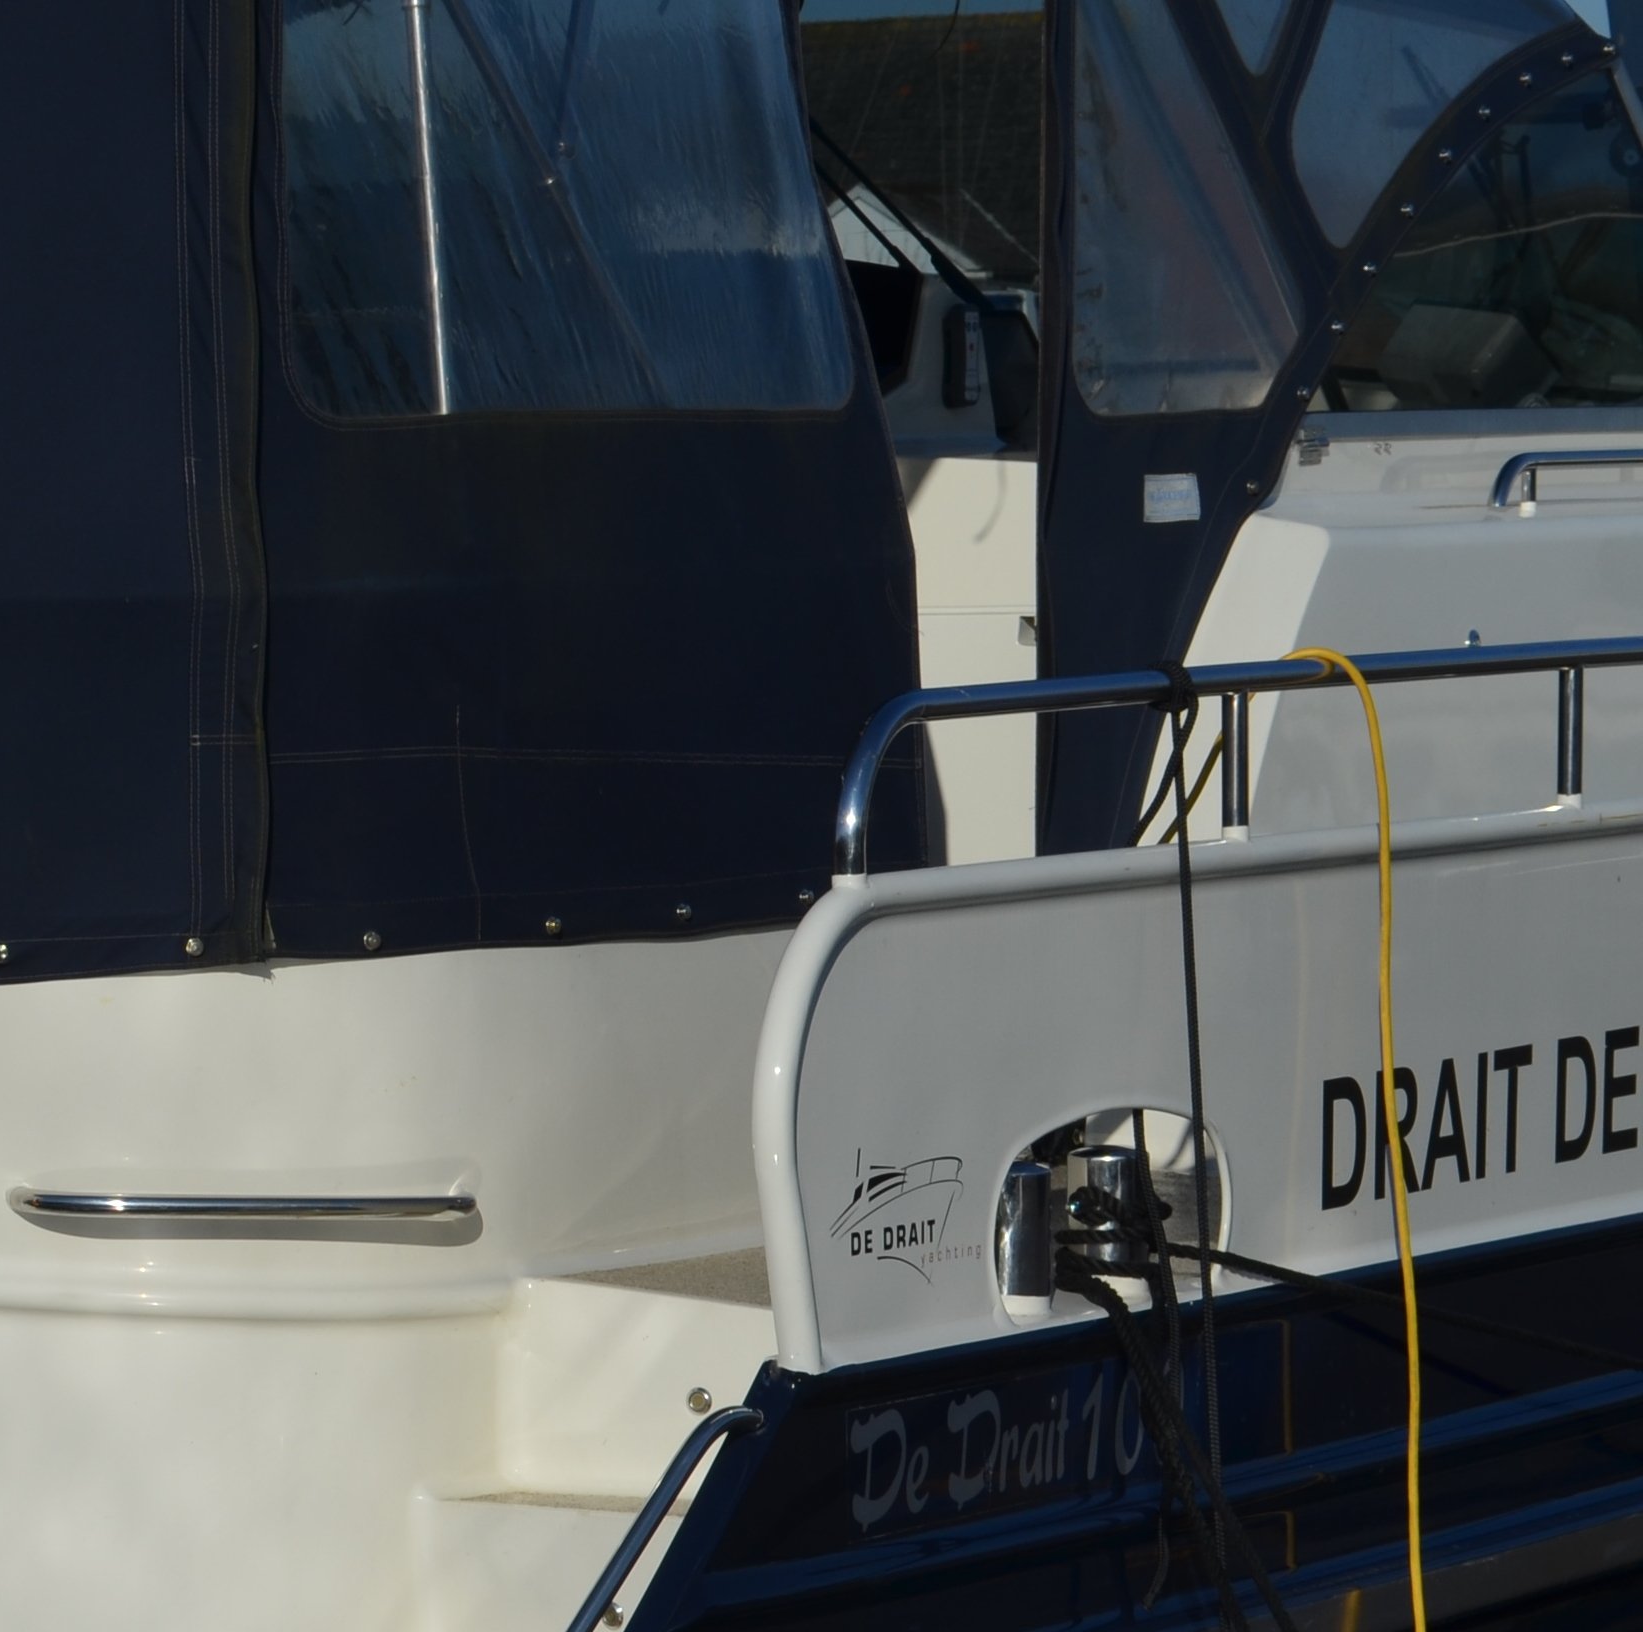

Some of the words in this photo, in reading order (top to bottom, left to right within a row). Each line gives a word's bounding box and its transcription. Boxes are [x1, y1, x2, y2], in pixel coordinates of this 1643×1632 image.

[1321, 1043, 1533, 1211] DRAIT
[1554, 1025, 1640, 1164] DE
[850, 1229, 873, 1257] DE
[883, 1218, 936, 1251] DRAIT
[920, 1244, 982, 1267] yachting
[850, 1407, 929, 1532] De
[947, 1387, 1069, 1511] Drait
